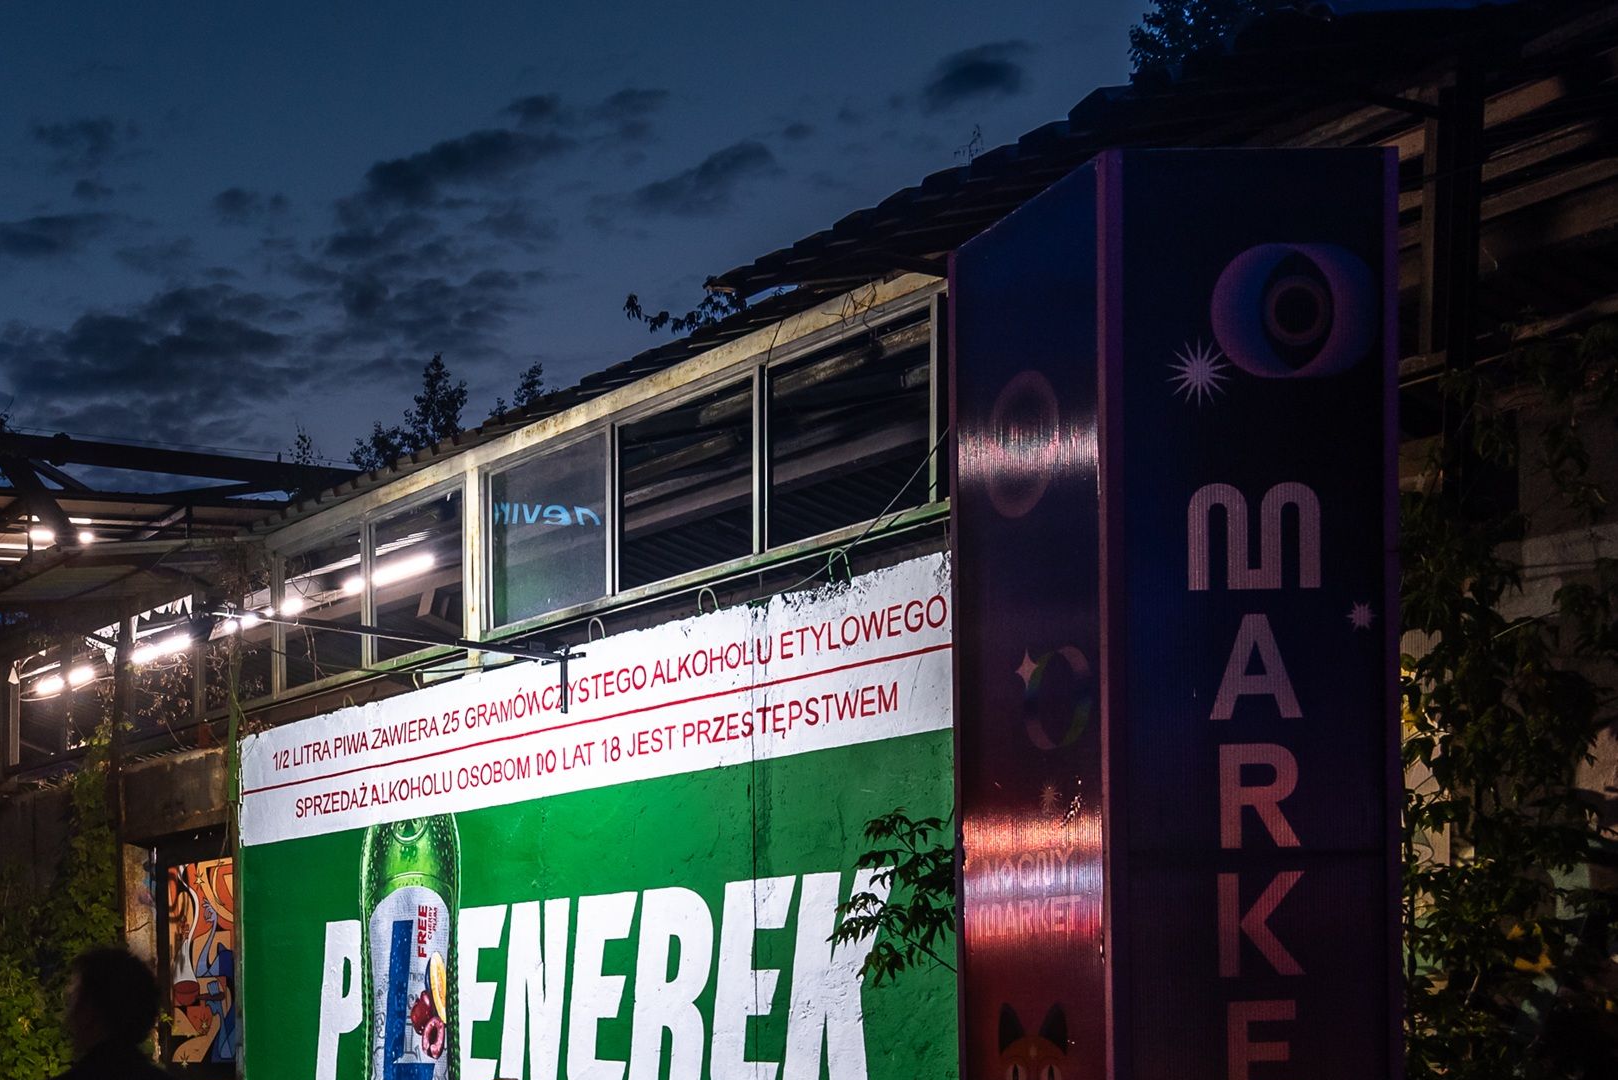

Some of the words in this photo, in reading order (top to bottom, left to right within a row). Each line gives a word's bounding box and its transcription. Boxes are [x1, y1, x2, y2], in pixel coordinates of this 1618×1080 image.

[273, 750, 290, 771] 1/2
[293, 738, 332, 767] LITRA
[334, 731, 369, 759] PIWA
[371, 716, 439, 750] ZAWIERA
[442, 710, 460, 736] 25
[465, 687, 540, 729] GRAMÓW
[542, 664, 647, 711] CZYSTEGO
[650, 635, 773, 688] ALKOHOLU
[780, 594, 948, 661] ETYLOWEGO
[295, 781, 369, 819] SPRZEDAŻ
[370, 769, 453, 806] ALKOHOLU
[457, 755, 531, 790] OSOBOM
[536, 749, 557, 776] DO
[563, 742, 596, 771] LAT
[602, 735, 621, 764] 18
[626, 724, 677, 758] JEST
[682, 681, 899, 748] PRZESTĘPSTWEM
[417, 904, 428, 959] FREE
